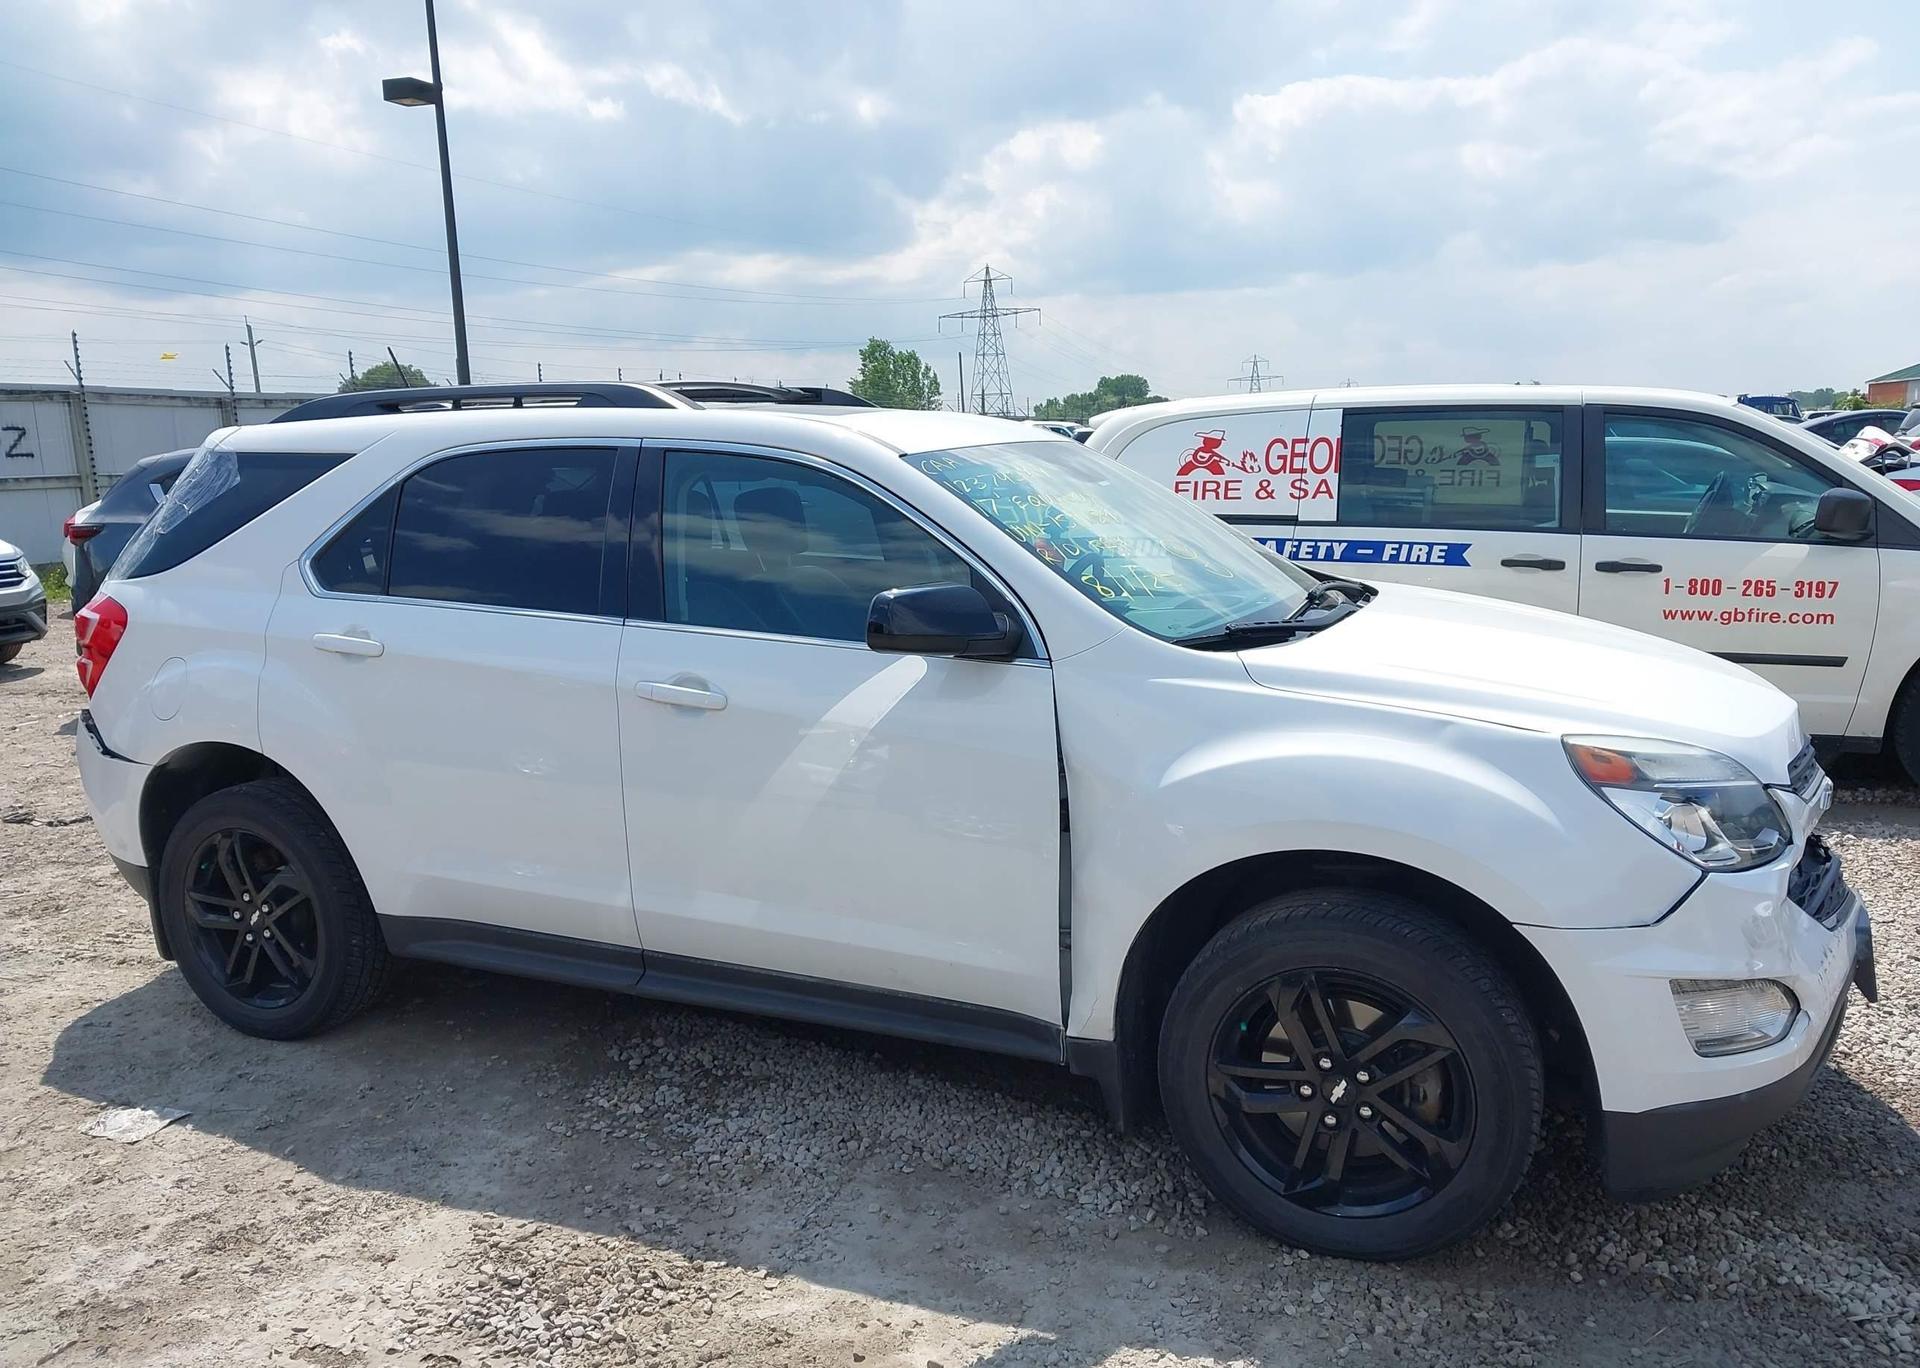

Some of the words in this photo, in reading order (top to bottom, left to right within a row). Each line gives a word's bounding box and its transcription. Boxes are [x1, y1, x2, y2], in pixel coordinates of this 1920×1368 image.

[1174, 479, 1243, 501] FIRE
[1255, 479, 1276, 500] &
[1289, 478, 1334, 500] SA
[1382, 543, 1449, 564] FIRE
[1662, 607, 1836, 626] www.gbfire.com
